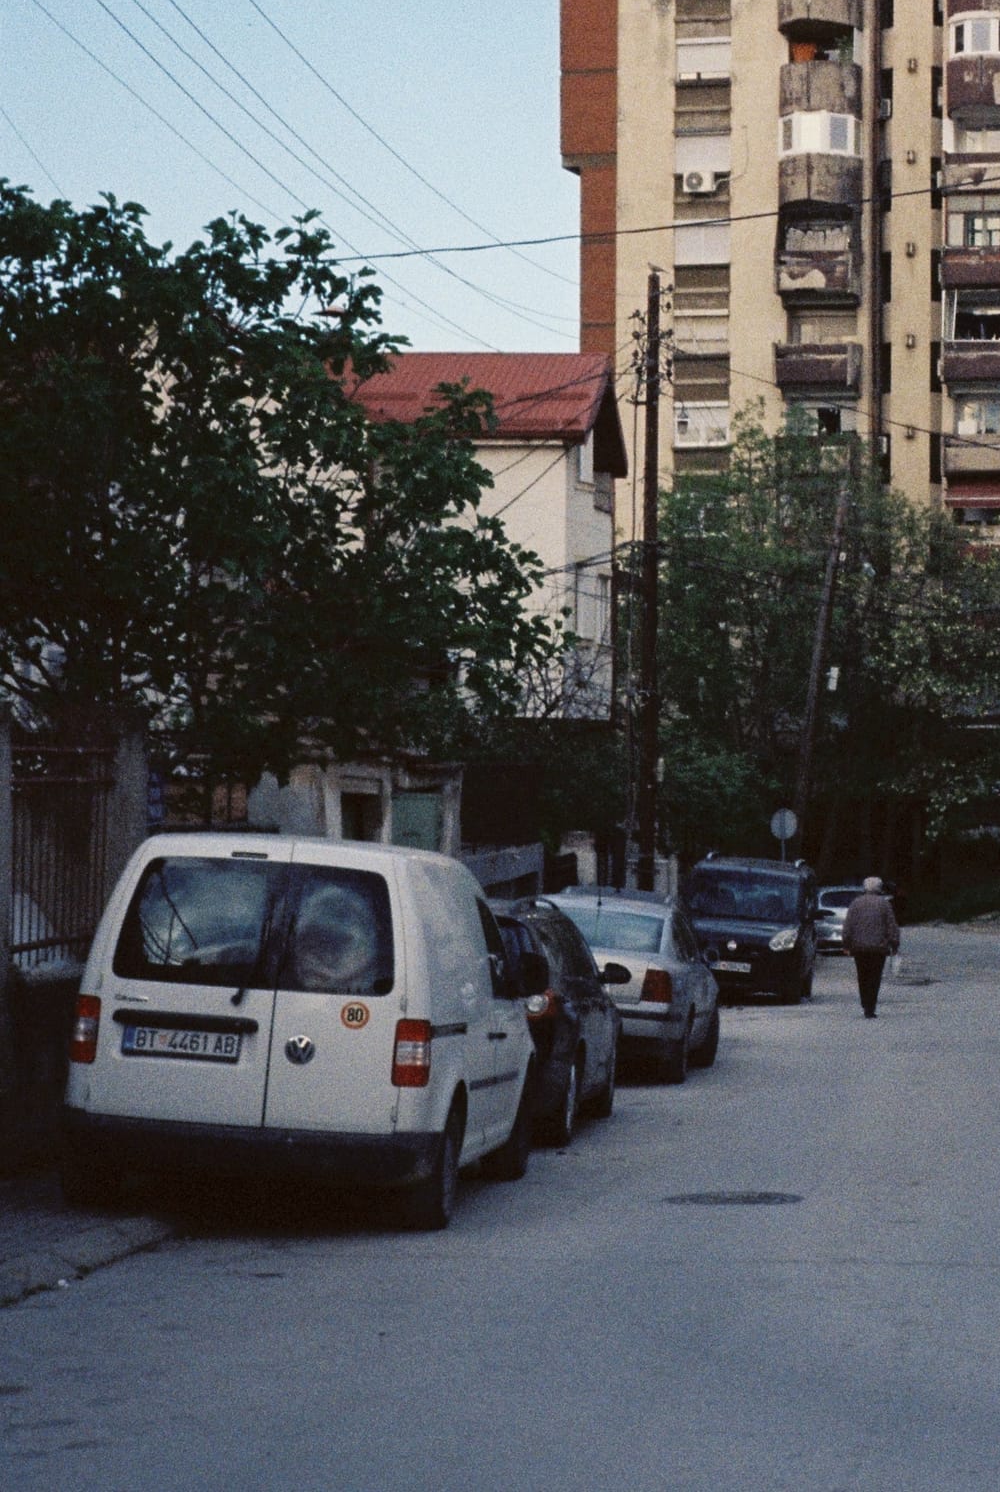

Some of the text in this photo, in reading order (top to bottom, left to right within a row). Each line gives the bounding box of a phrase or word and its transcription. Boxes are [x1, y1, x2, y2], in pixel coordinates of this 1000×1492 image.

[346, 1007, 364, 1023] 80
[136, 1029, 235, 1054] BT 4461 AB
